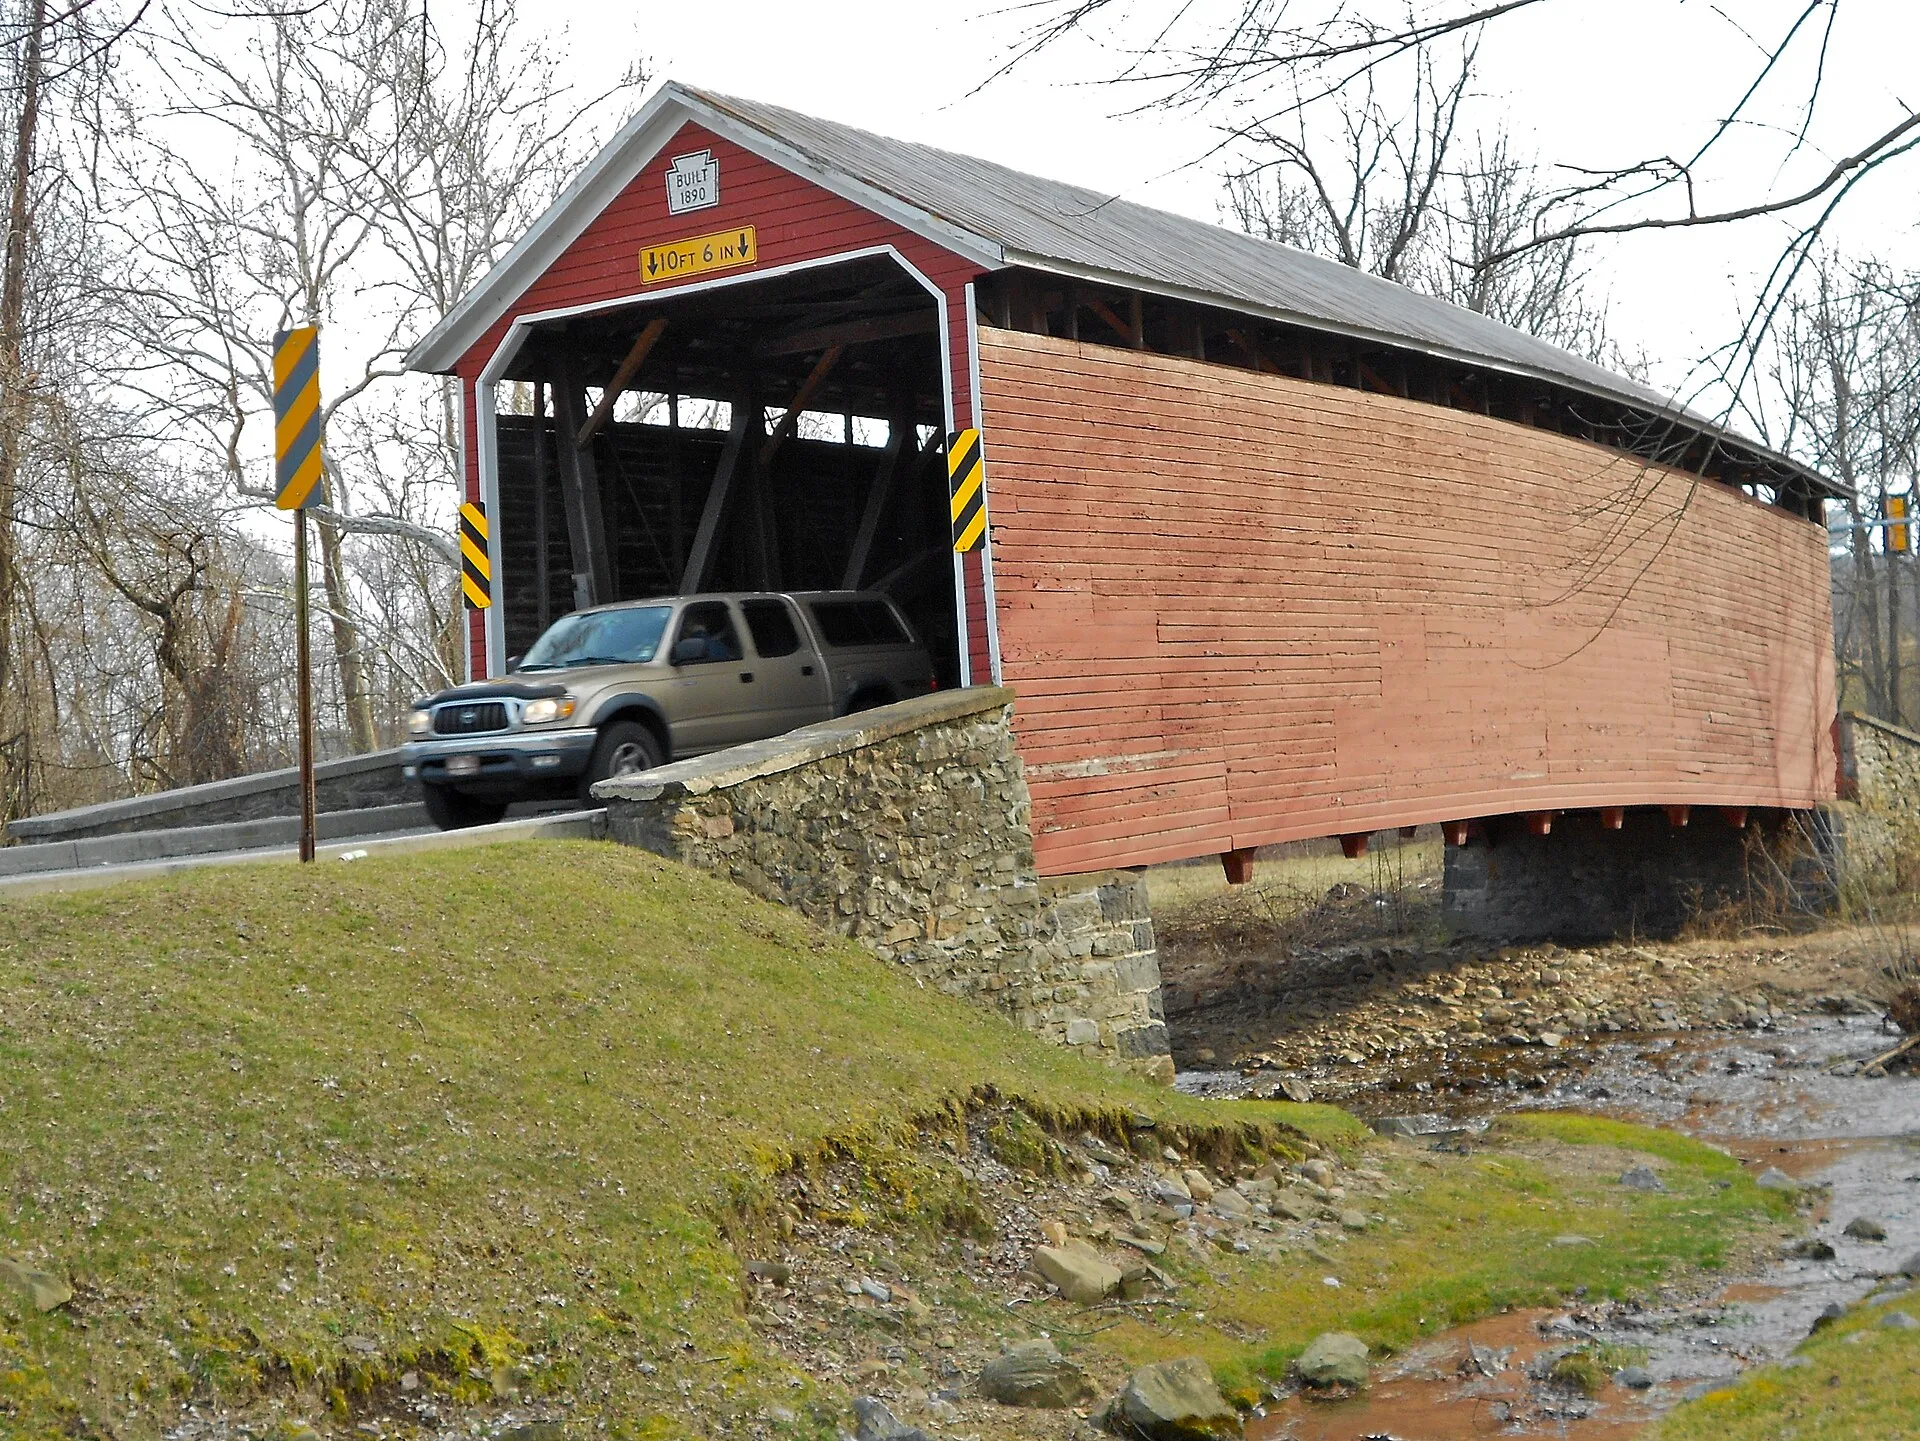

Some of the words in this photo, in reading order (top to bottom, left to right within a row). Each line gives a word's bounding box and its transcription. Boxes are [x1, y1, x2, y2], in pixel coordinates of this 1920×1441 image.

[676, 168, 708, 188] BUILT
[680, 187, 706, 204] 1890
[702, 243, 713, 262] 6
[719, 245, 734, 260] IN
